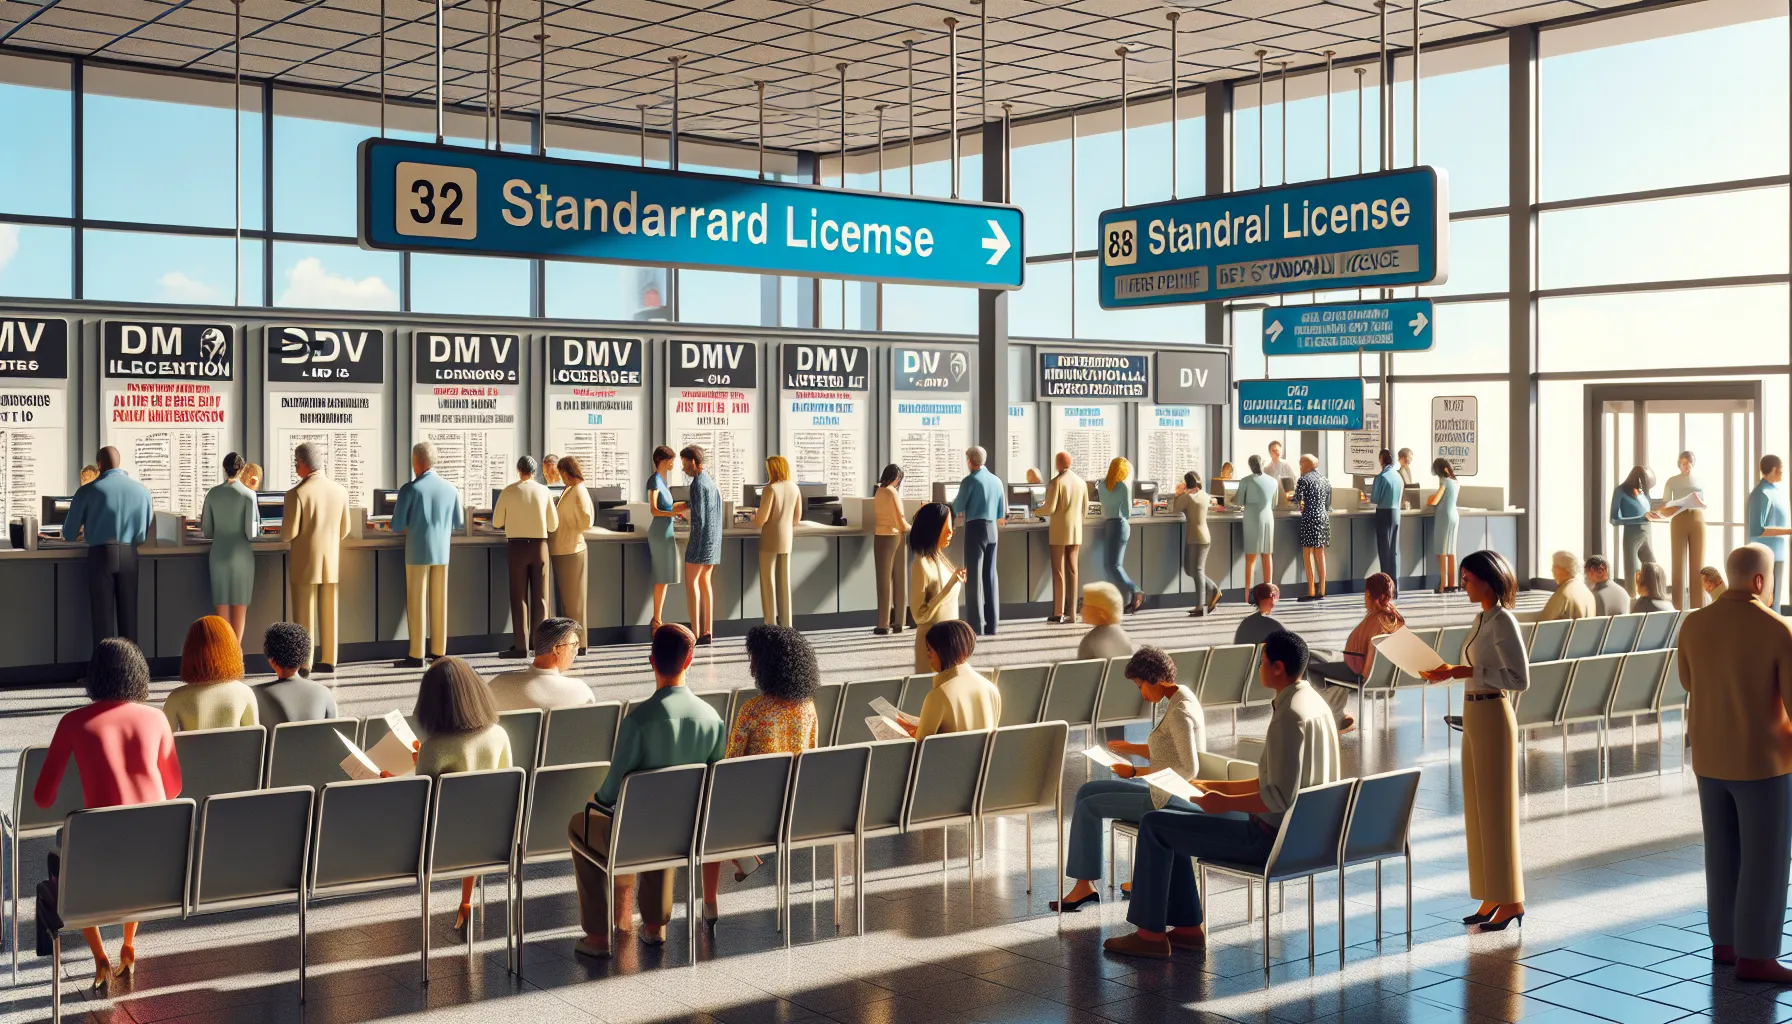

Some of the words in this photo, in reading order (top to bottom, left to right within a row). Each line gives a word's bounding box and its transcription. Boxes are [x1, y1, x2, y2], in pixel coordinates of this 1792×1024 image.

[410, 179, 464, 226] 32
[501, 178, 768, 245] Standarrard
[786, 205, 935, 257] Licemse
[1149, 204, 1270, 256] Standral
[1283, 196, 1411, 240] License
[563, 339, 632, 367] DMV
[681, 343, 745, 370] DMV
[796, 346, 859, 373] DMV
